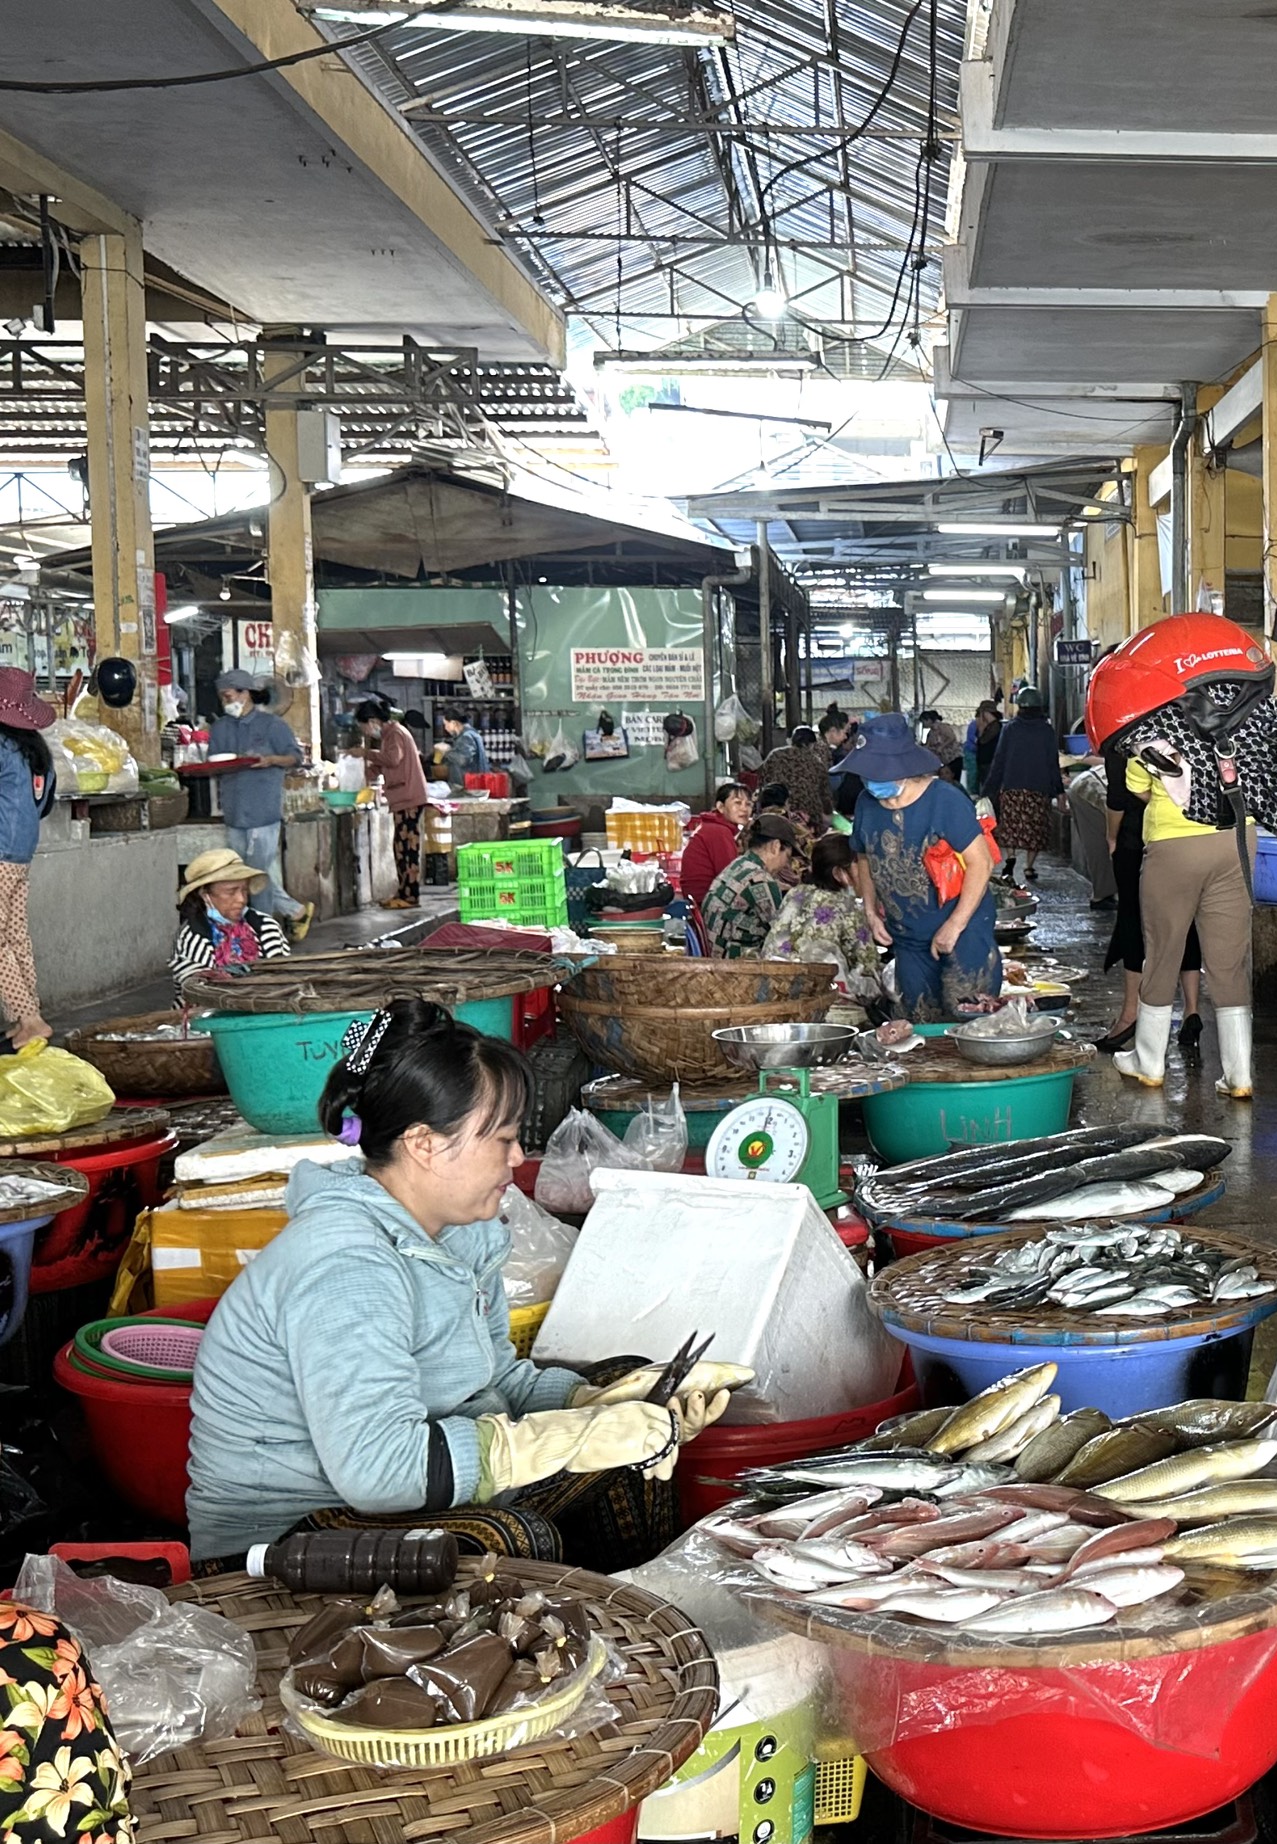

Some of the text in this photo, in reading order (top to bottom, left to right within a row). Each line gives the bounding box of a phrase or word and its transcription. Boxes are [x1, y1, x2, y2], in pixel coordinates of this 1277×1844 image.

[1064, 643, 1085, 653] WC
[1201, 647, 1244, 661] LOTTERIA
[574, 650, 645, 666] PHƯỢNG
